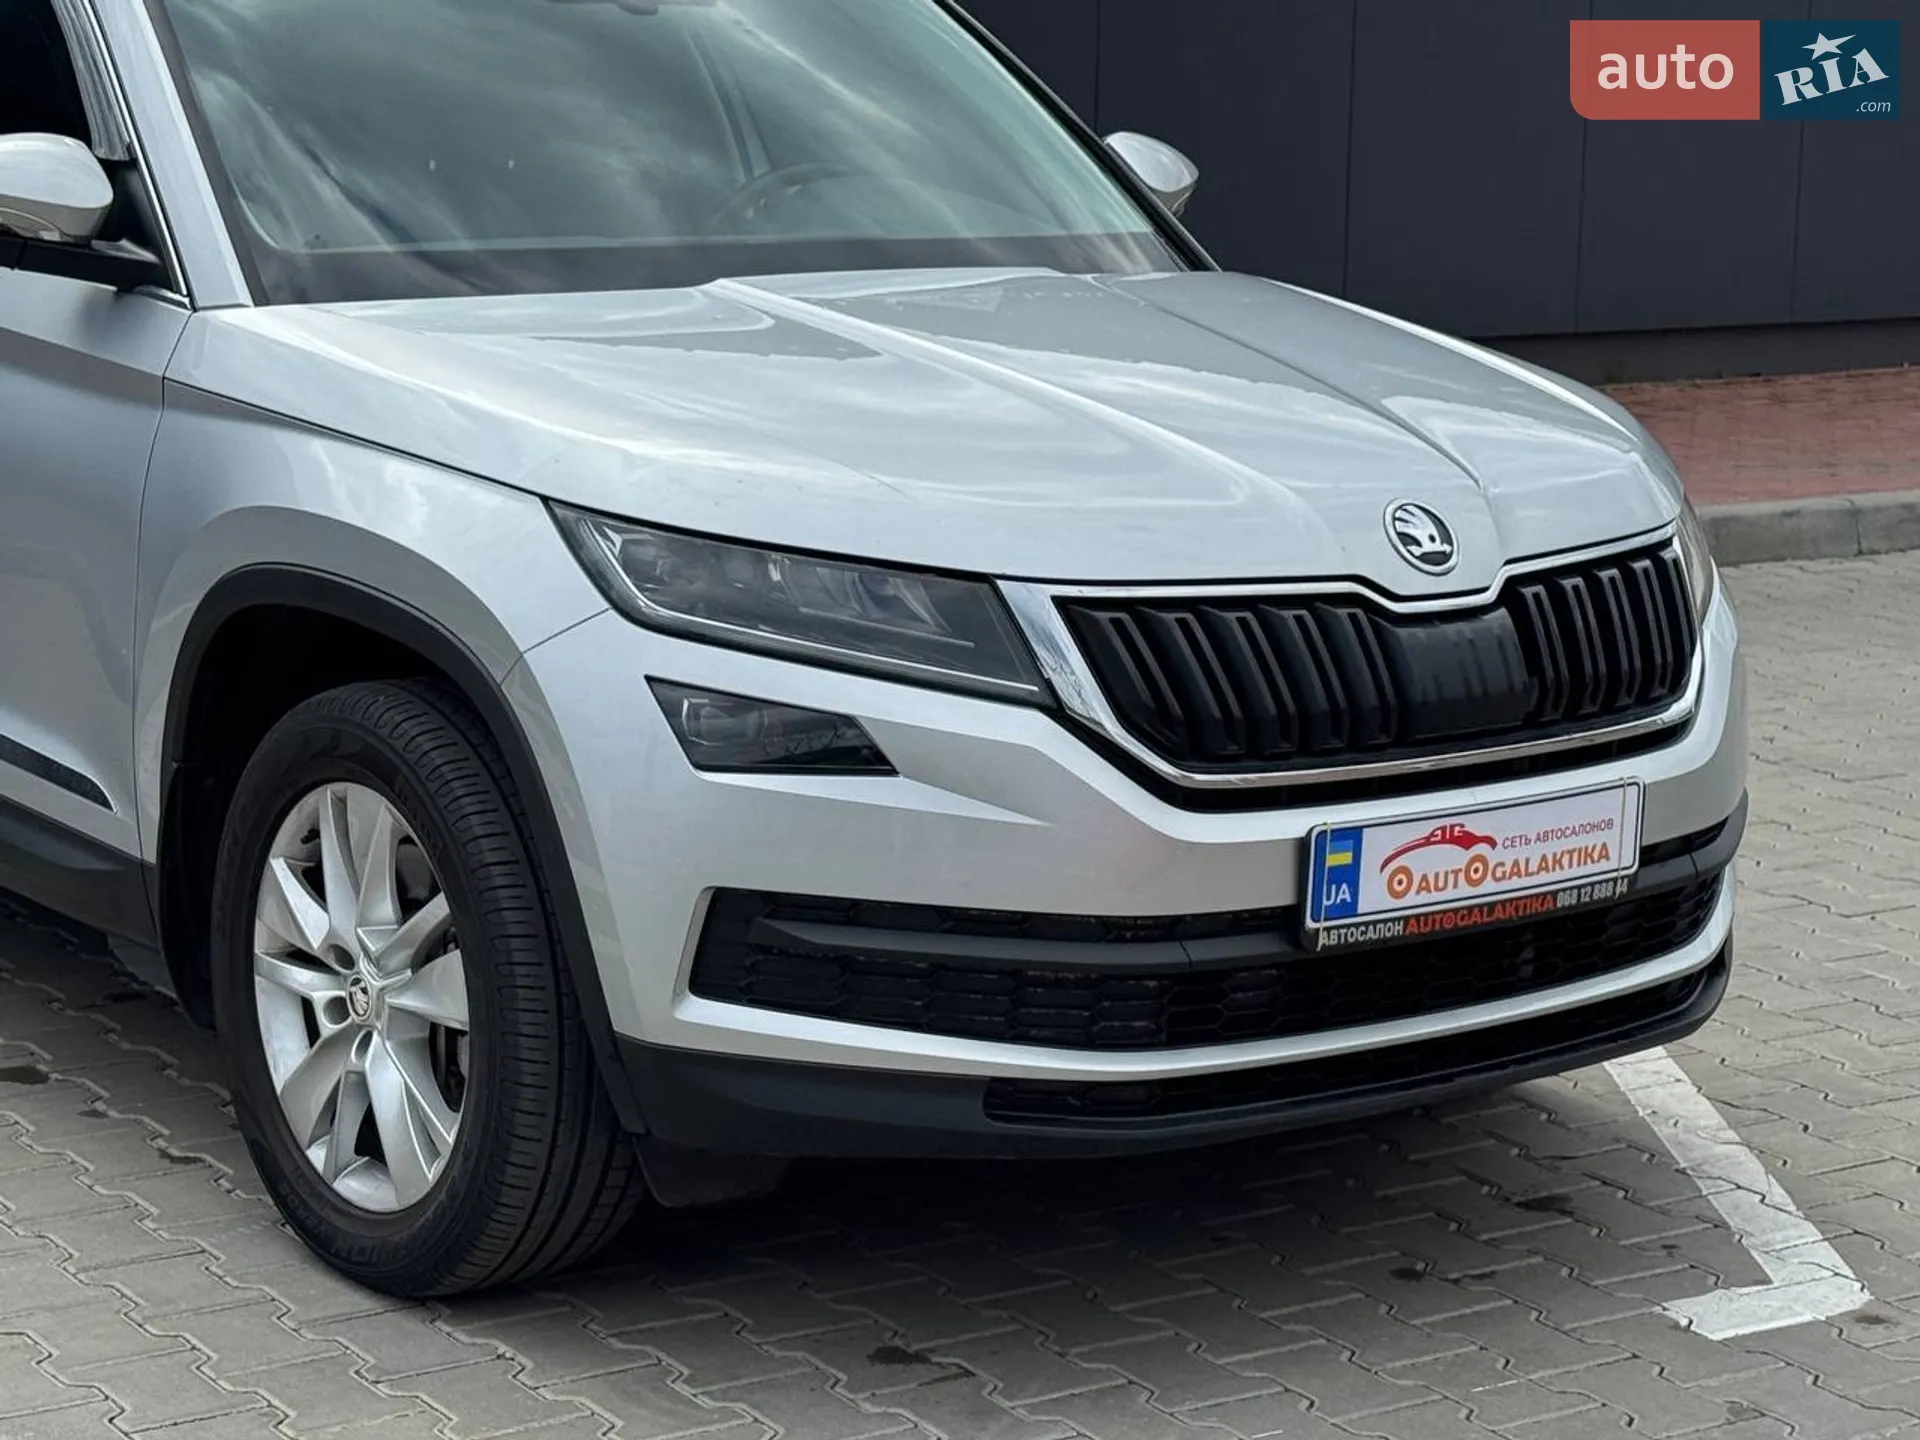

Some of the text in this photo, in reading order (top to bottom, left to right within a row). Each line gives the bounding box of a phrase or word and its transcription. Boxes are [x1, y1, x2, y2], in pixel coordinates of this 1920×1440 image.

[1502, 818, 1614, 849] СЕТЬ АВТОСАЛОНОВ
[1323, 882, 1352, 906] UA
[1319, 919, 1404, 946] АВТОСАЛОН
[1405, 893, 1554, 935] AUTOGALAKTIKA
[1580, 885, 1592, 903] 12
